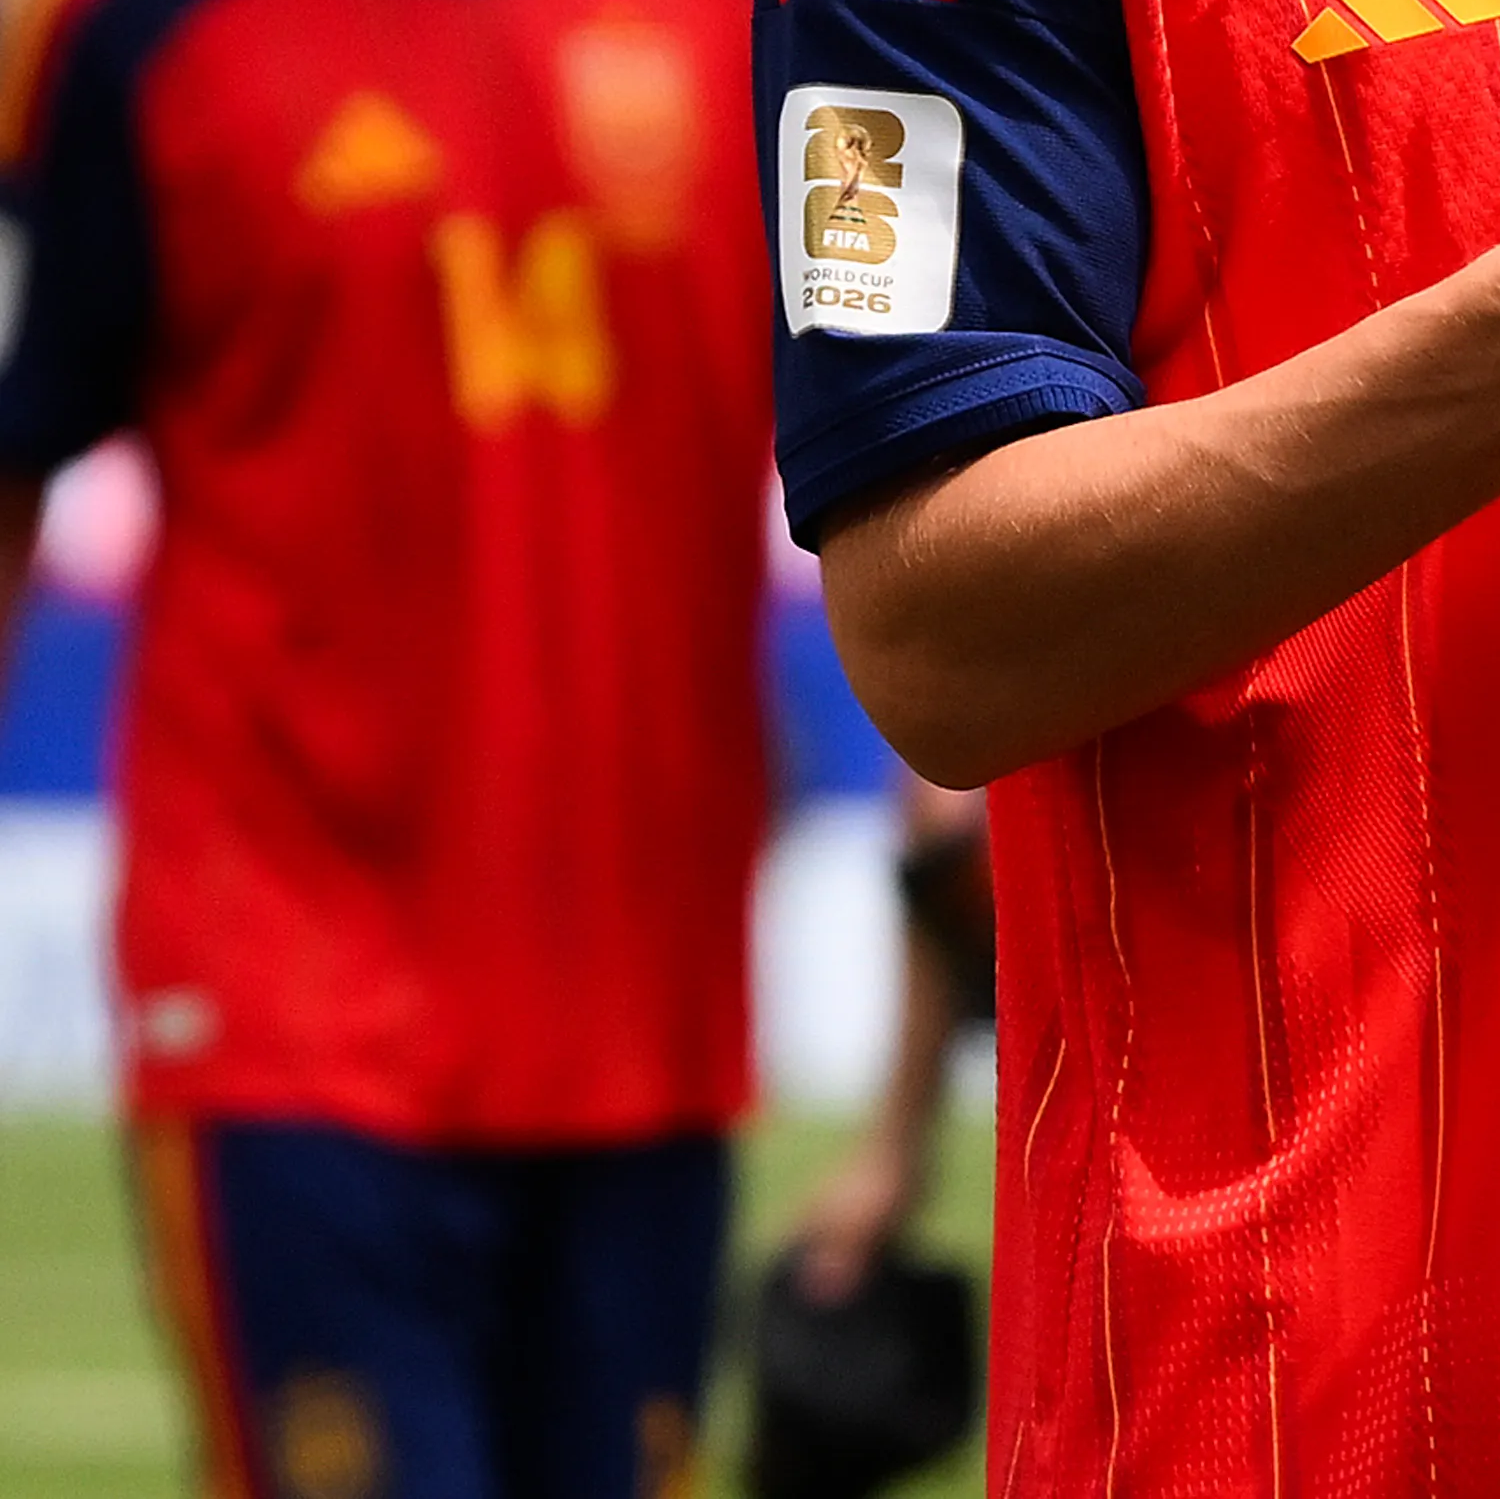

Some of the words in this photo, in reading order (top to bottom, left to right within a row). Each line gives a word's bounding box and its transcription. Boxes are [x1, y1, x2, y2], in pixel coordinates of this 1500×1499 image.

[822, 229, 871, 251] FIFA
[860, 272, 894, 288] CUP
[803, 285, 891, 314] 2026
[430, 209, 608, 429] 14
